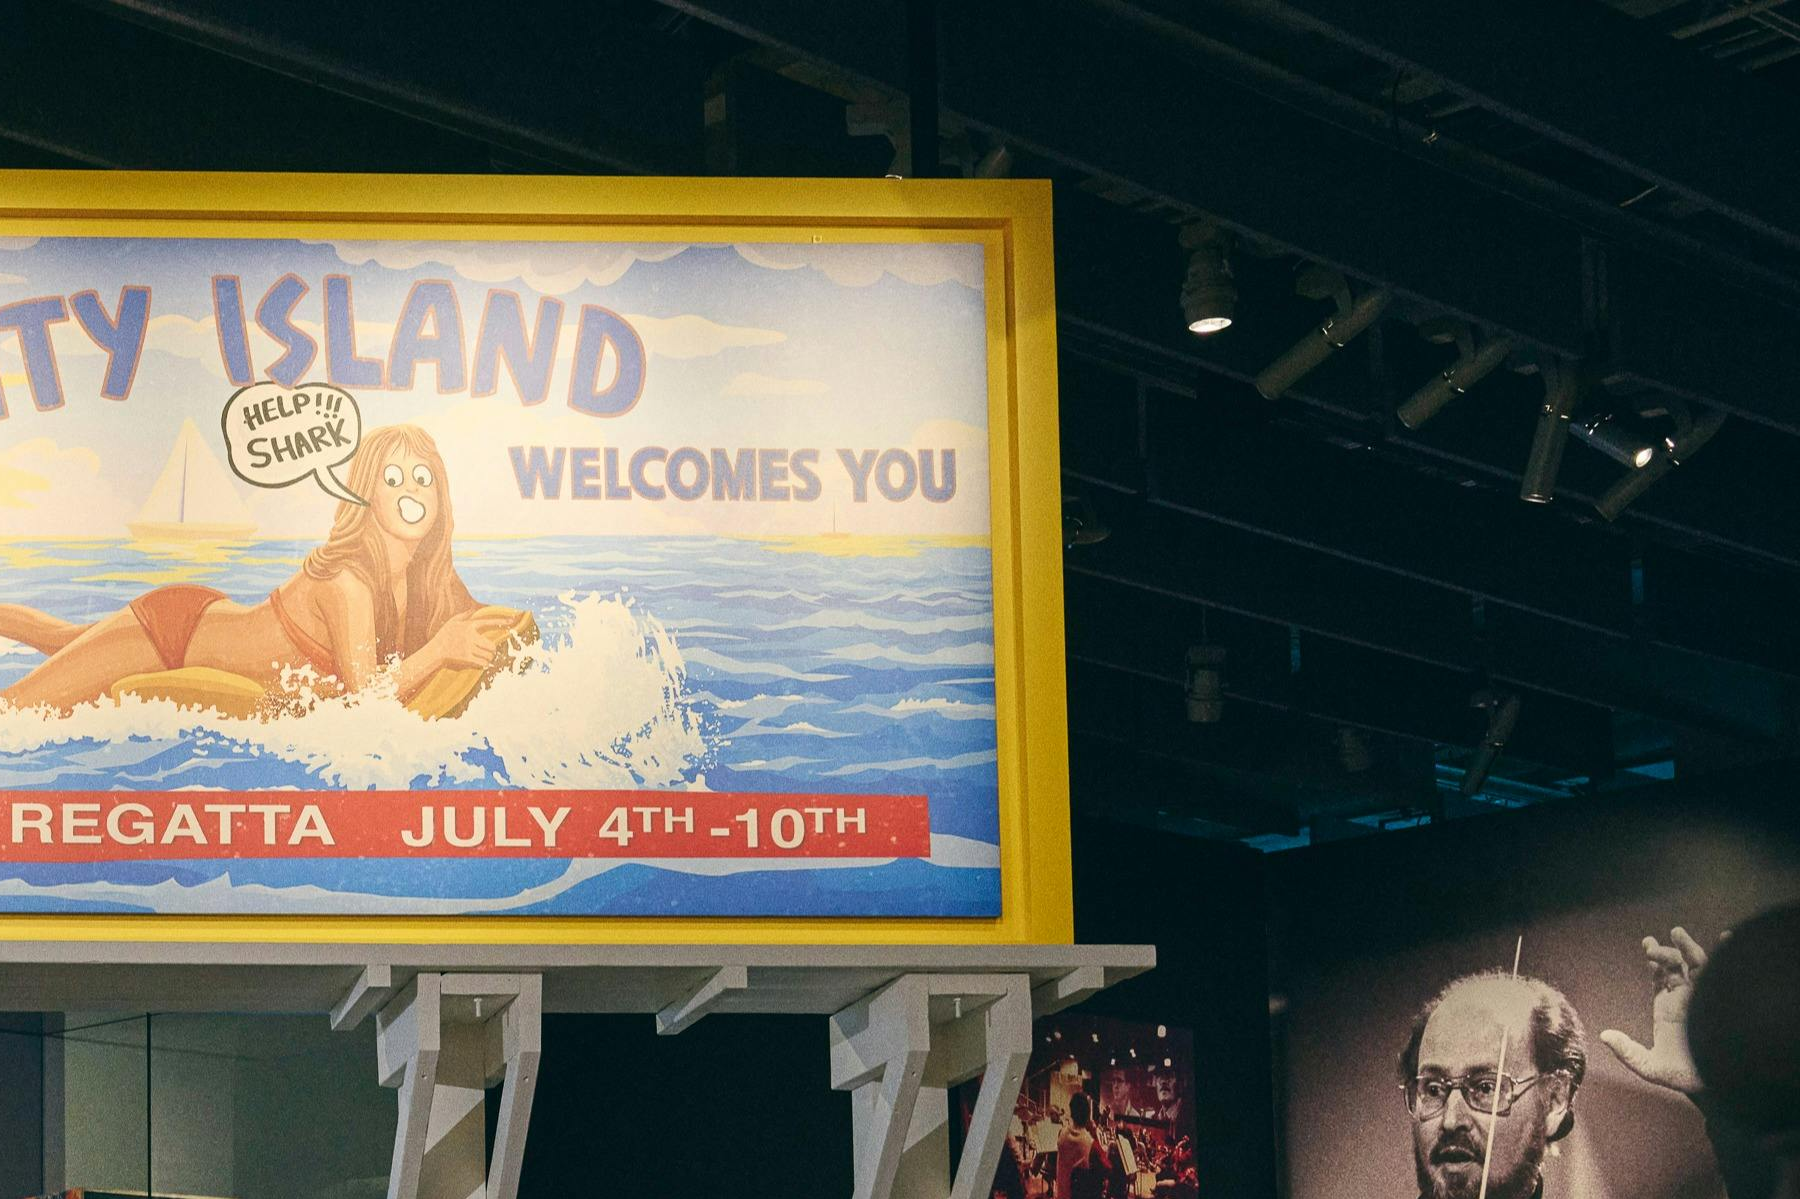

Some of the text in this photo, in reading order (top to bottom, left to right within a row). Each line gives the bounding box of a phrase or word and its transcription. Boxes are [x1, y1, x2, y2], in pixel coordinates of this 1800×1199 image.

[211, 272, 648, 418] ISLAND
[243, 392, 343, 431] HELP!!!
[246, 418, 351, 468] SHARK
[507, 446, 957, 503] WELCOMES YOU
[11, 803, 335, 846] REGATTA
[401, 806, 571, 847] JULY
